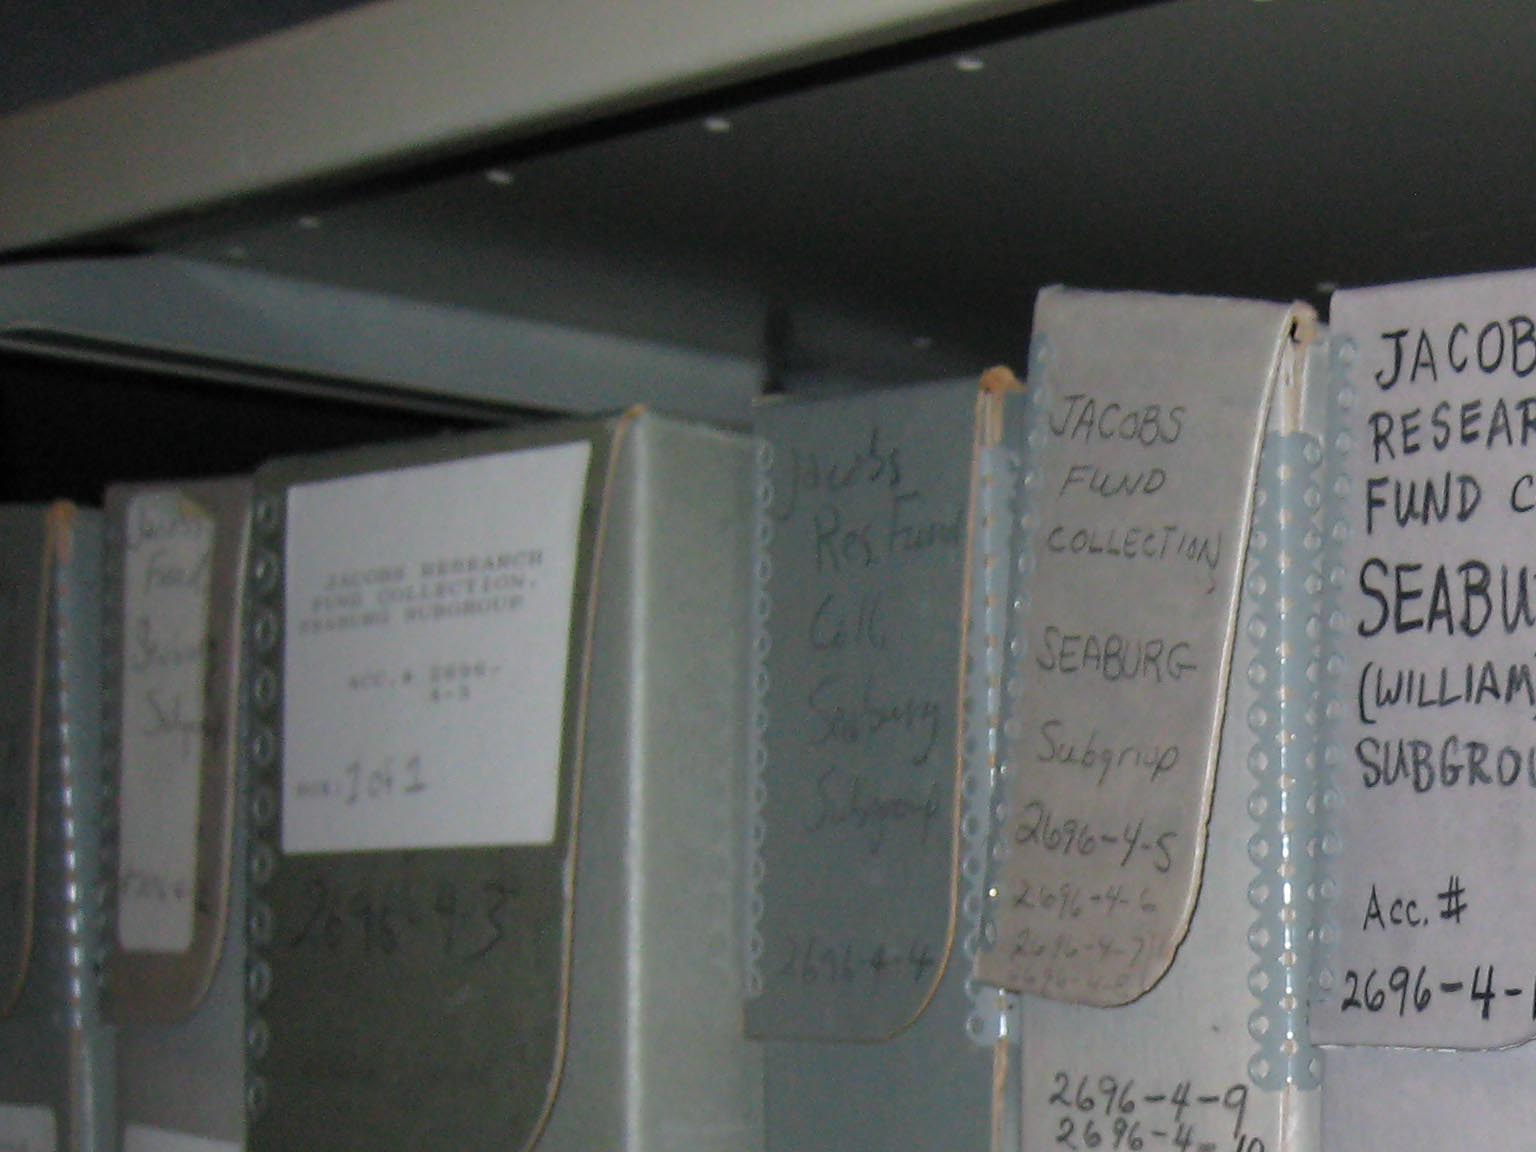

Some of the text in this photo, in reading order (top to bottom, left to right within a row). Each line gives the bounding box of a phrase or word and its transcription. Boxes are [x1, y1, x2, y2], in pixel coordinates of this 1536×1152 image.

[1049, 393, 1186, 446] JACOBS
[1059, 464, 1168, 499] FUND
[1366, 470, 1483, 534] FUND
[1036, 626, 1198, 683] SEABURG
[1362, 874, 1469, 932] Acc. #
[1047, 1069, 1250, 1139] 2696-4-9
